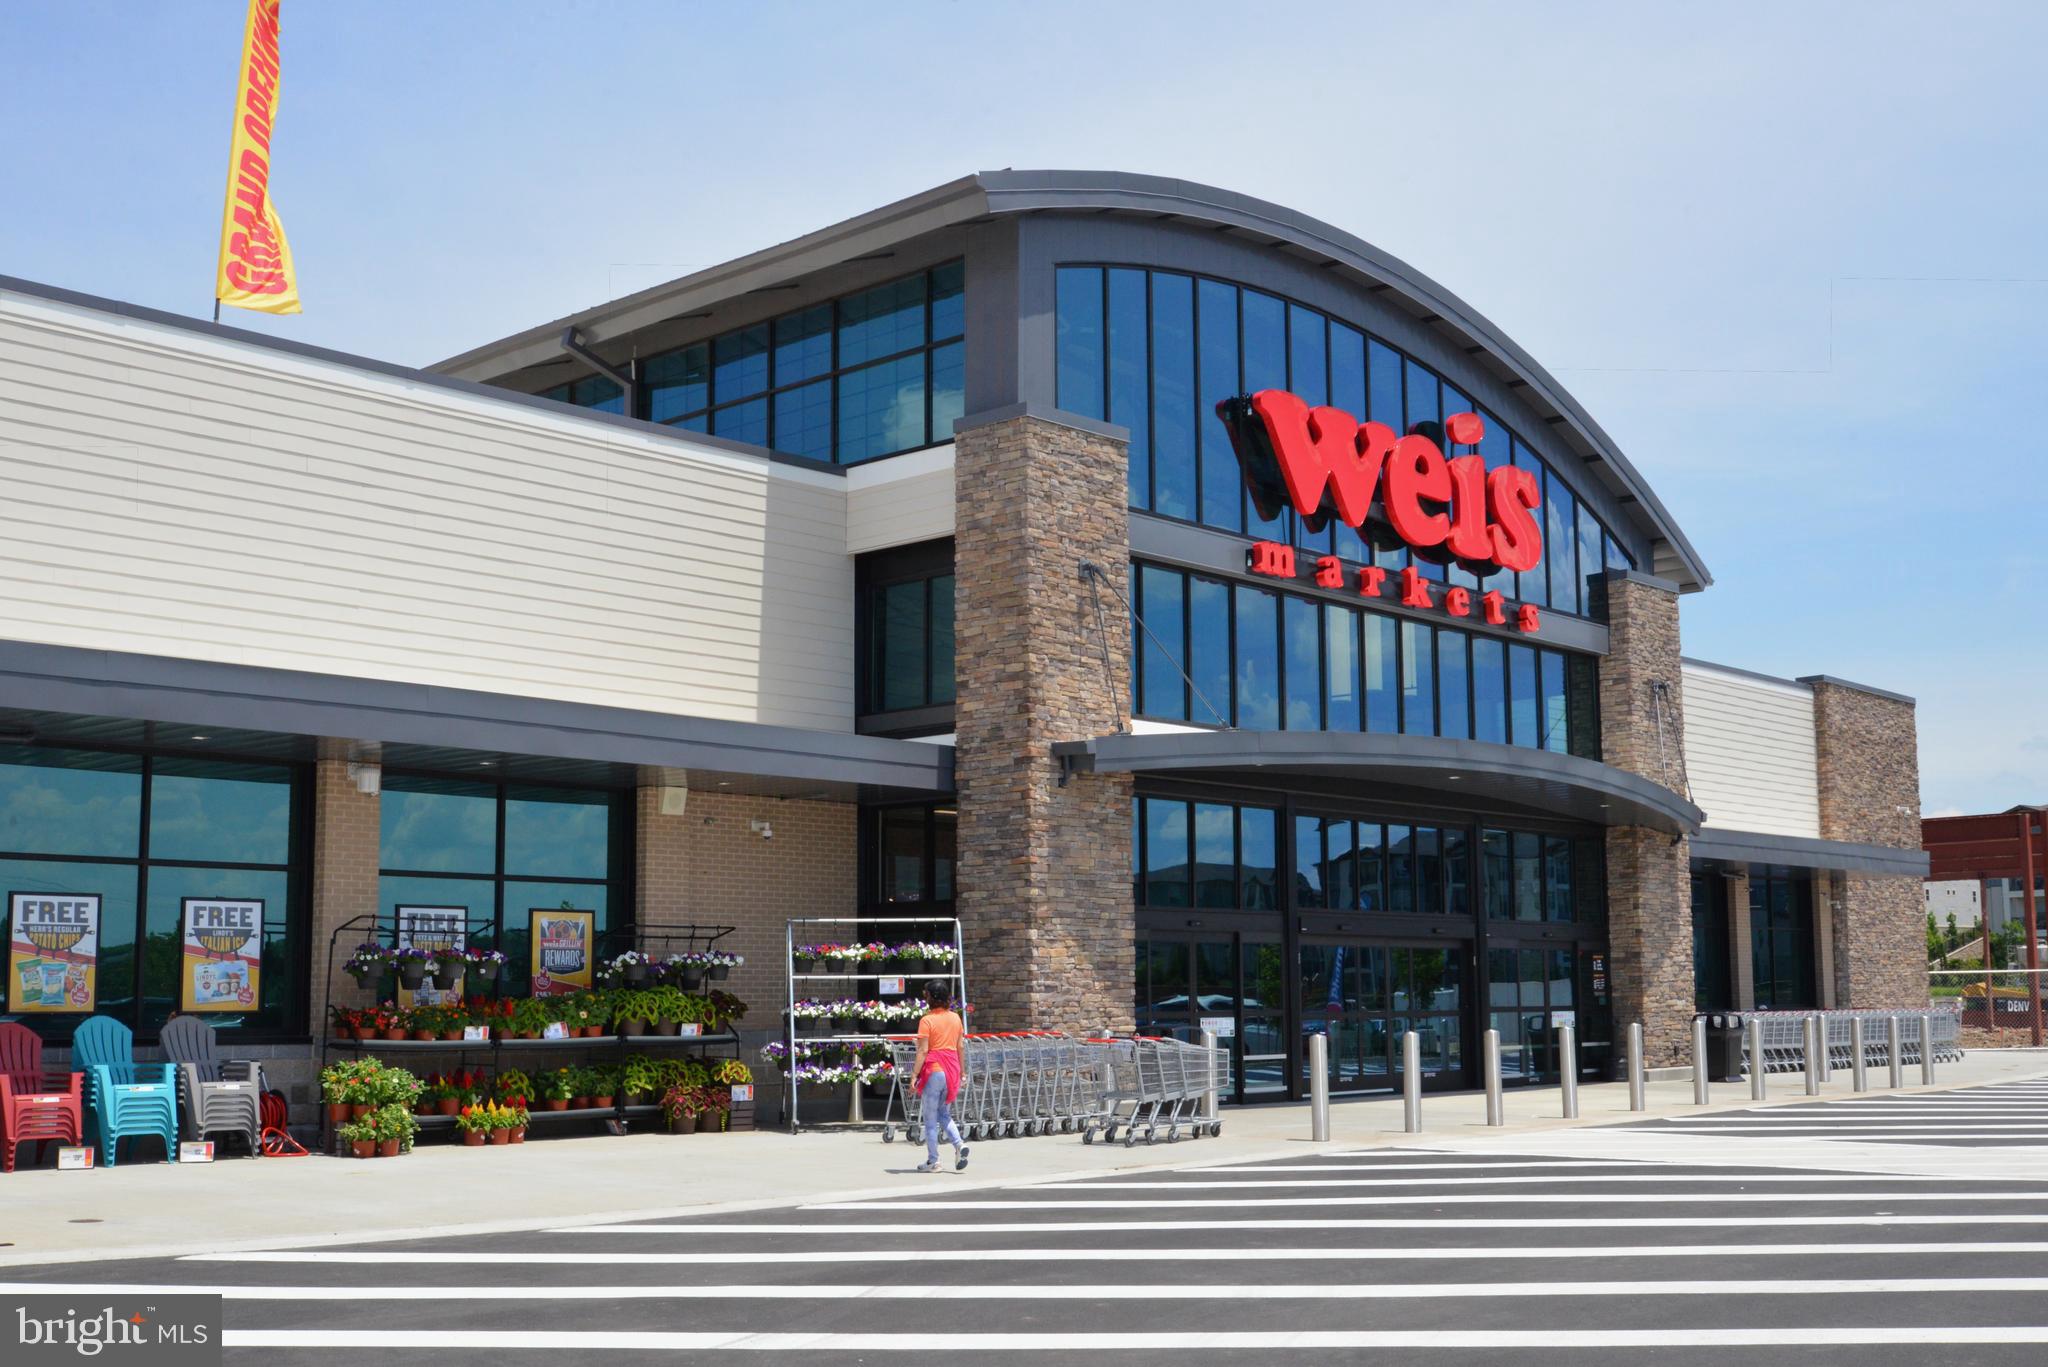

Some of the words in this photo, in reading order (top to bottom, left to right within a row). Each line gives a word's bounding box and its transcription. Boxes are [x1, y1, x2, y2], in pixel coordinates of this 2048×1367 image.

[226, 149, 288, 295] GRAND
[1250, 541, 1541, 633] markets
[22, 900, 89, 924] FREE
[193, 906, 253, 927] FREE
[407, 912, 459, 932] FREE
[29, 932, 57, 950] POTATO
[545, 949, 580, 967] REWARDS
